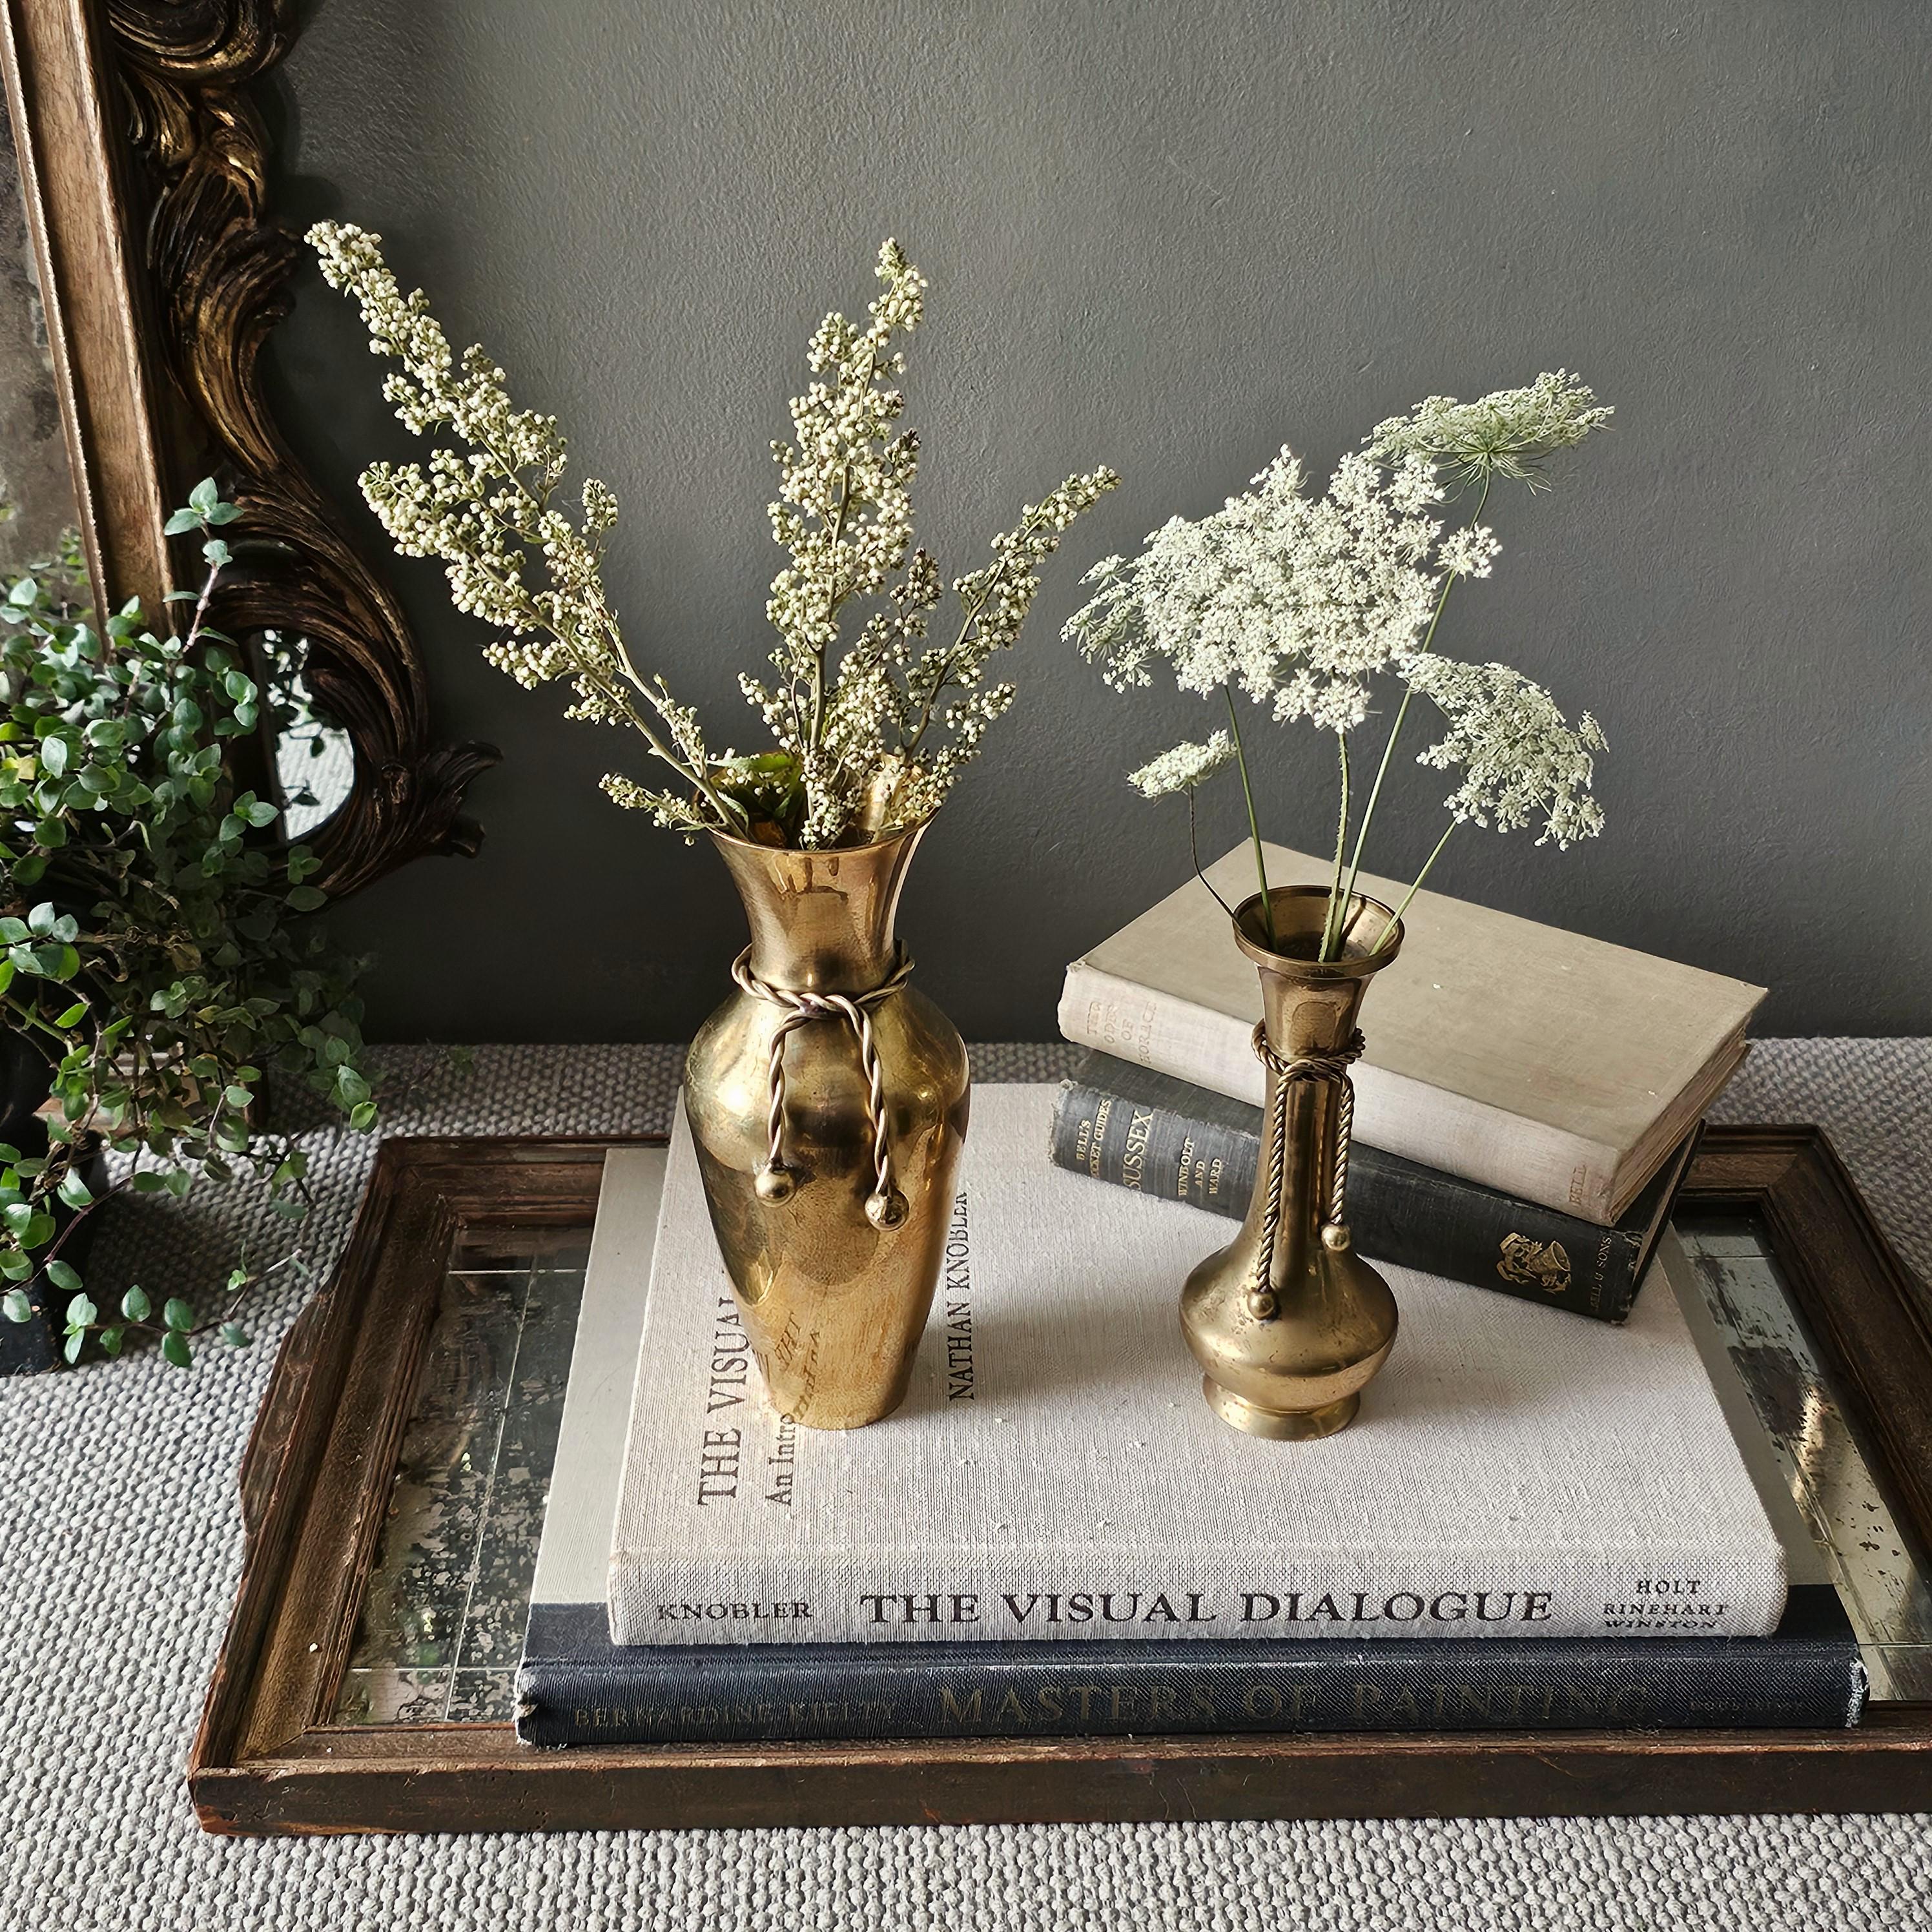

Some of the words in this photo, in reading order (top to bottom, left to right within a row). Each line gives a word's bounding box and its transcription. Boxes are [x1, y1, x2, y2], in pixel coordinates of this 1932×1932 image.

[1121, 1018, 1133, 1041] OF
[1093, 1099, 1112, 1141] GUIDES
[1076, 1120, 1091, 1161] BELL'S
[1123, 1110, 1153, 1192] SUSSEX
[1195, 1160, 1206, 1187] AND
[1209, 1158, 1222, 1194] WARD
[1596, 1236, 1612, 1269] SONS
[947, 1301, 974, 1401] NATHAN
[697, 1428, 741, 1506] THE
[765, 1473, 792, 1506] An
[1636, 1579, 1701, 1595] HOLT
[657, 1601, 813, 1621] KNOBLER
[859, 1593, 980, 1624] THE
[1001, 1592, 1217, 1623] VISUAL
[1239, 1591, 1553, 1622] DIALOGUE
[1603, 1603, 1730, 1615] RINEHART
[1603, 1620, 1718, 1629] WINSTON
[939, 1685, 1216, 1724] MASTERS
[1245, 1683, 1319, 1720] OF
[1353, 1682, 1649, 1720] PAINTING
